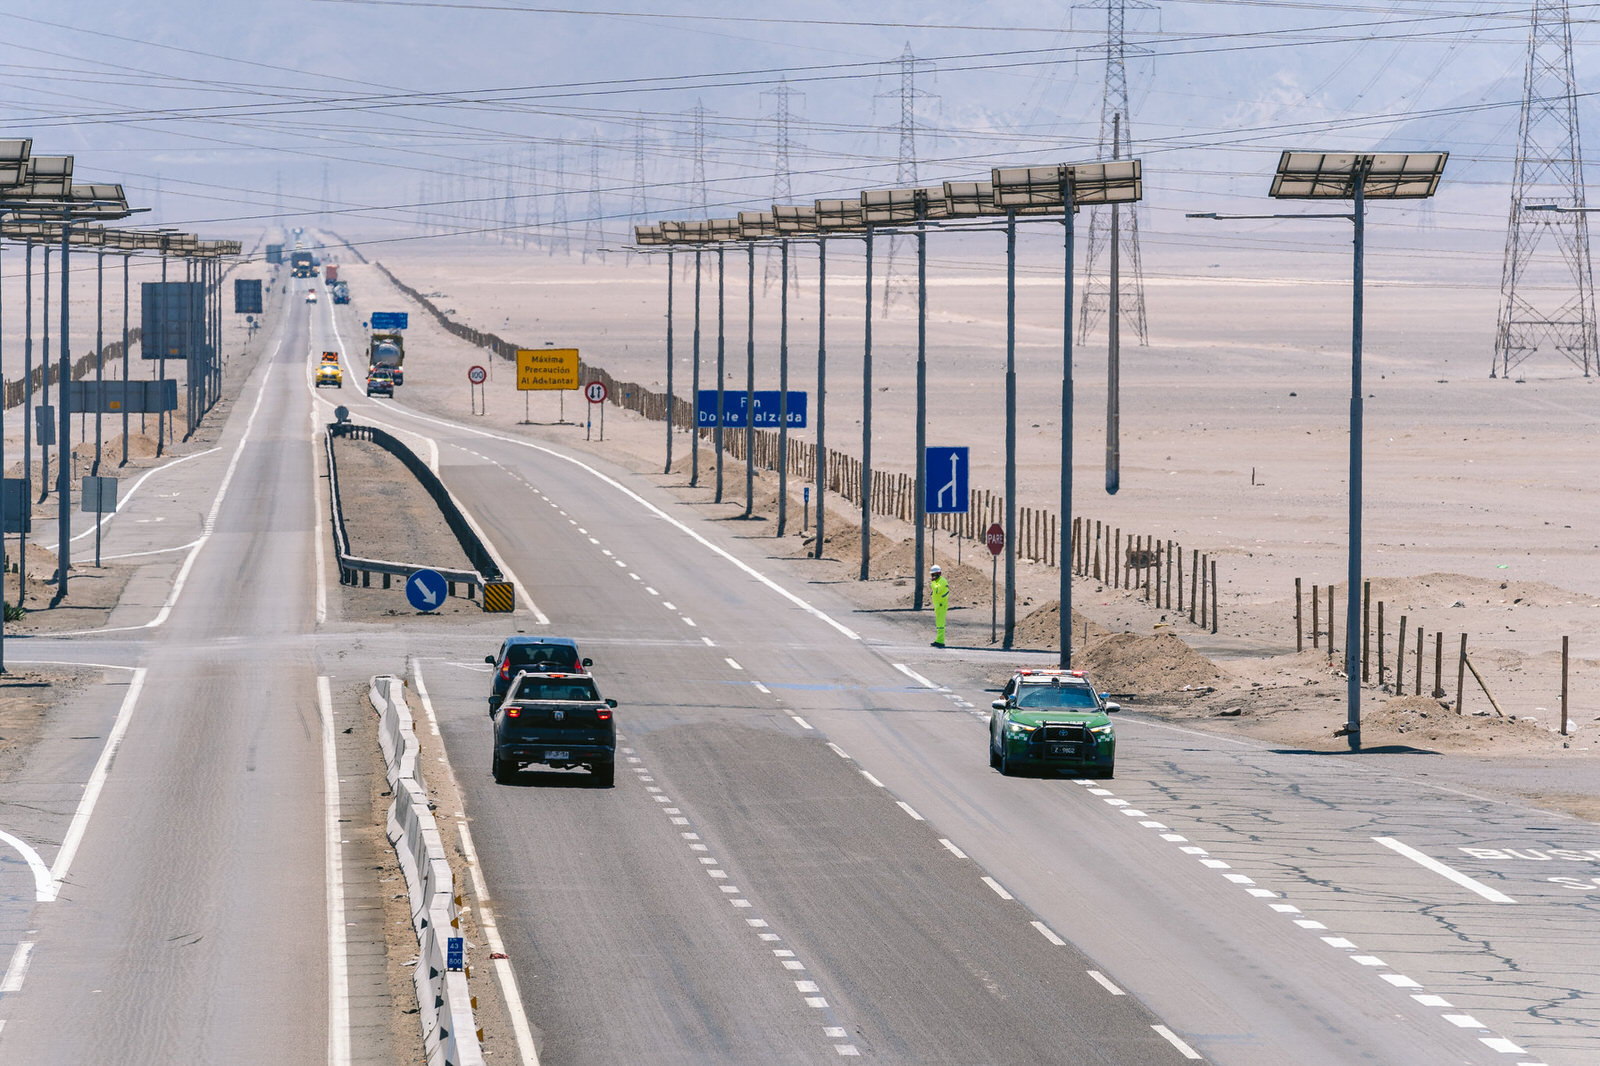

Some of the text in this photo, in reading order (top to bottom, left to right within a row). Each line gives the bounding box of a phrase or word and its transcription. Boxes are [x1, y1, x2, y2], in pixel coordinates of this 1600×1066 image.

[525, 365, 570, 374] Precaución
[521, 377, 573, 385] Al Adelantar
[740, 397, 761, 408] Fn
[699, 411, 802, 422] Dole alzda
[987, 534, 1003, 544] PARE
[1546, 876, 1600, 890] S
